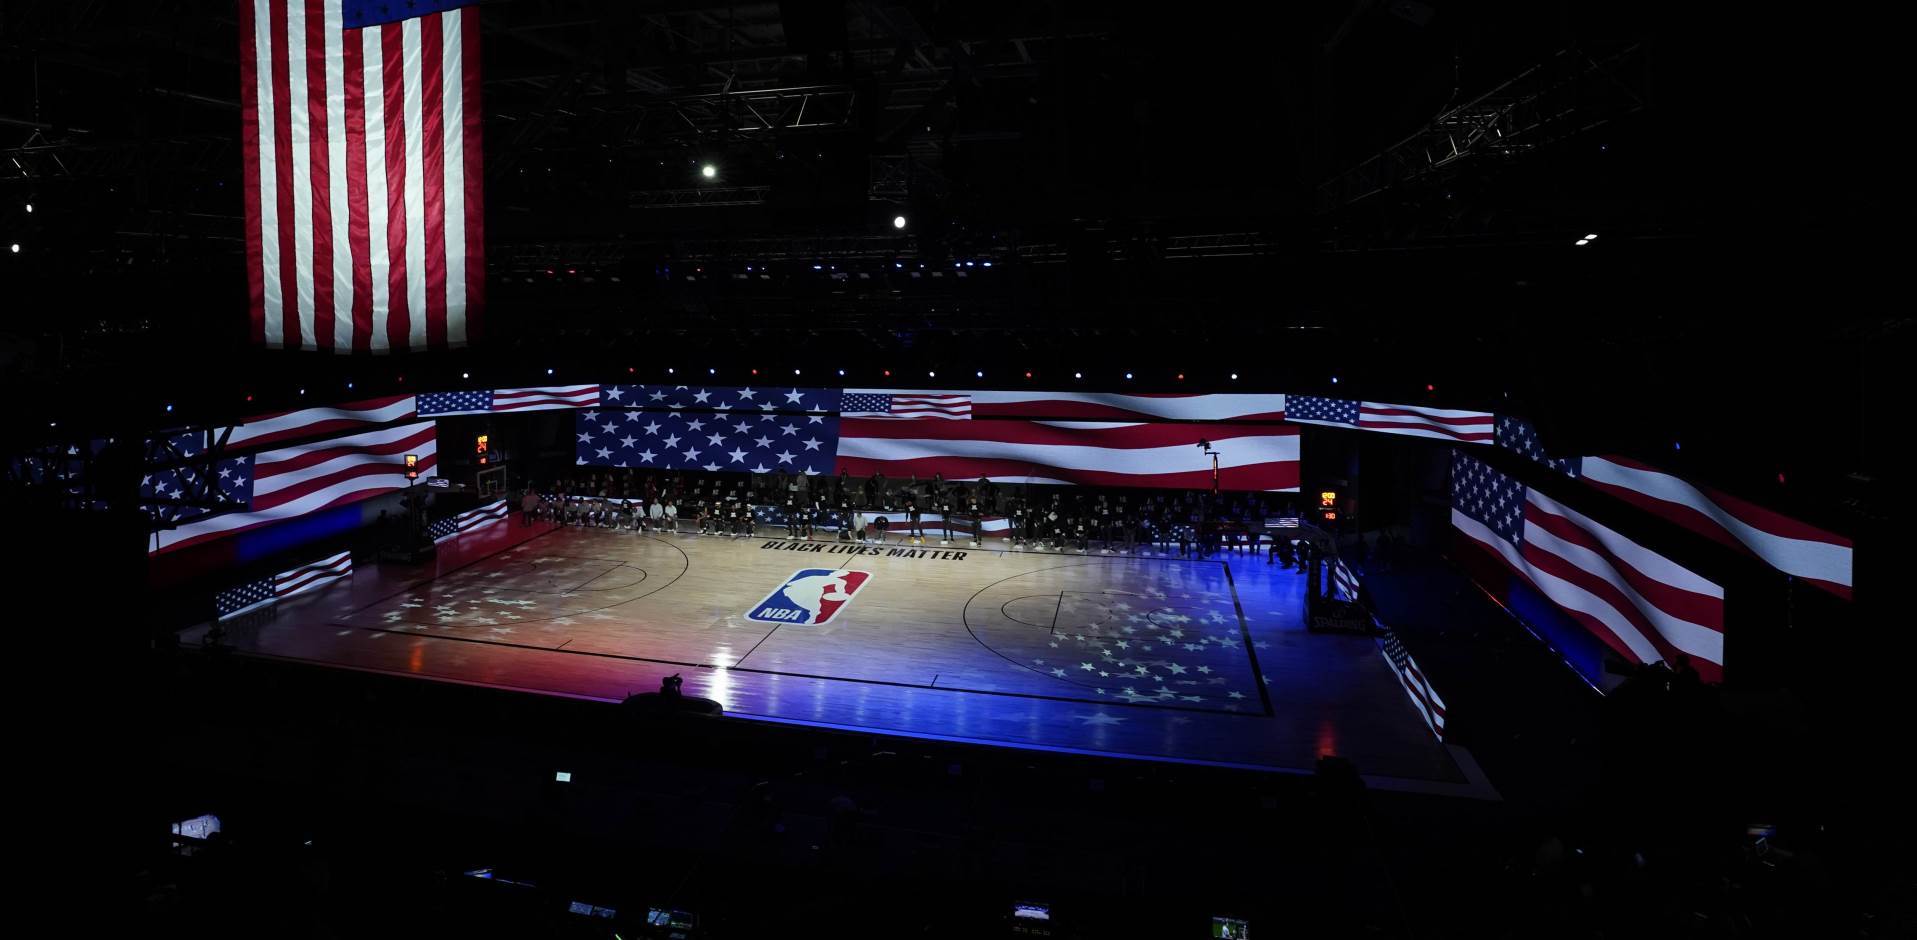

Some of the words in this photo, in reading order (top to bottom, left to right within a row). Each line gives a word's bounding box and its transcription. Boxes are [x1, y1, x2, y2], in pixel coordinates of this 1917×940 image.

[761, 541, 824, 552] BLACK
[828, 544, 884, 556] LIVES
[887, 548, 968, 560] MATTER
[758, 607, 802, 621] NBA
